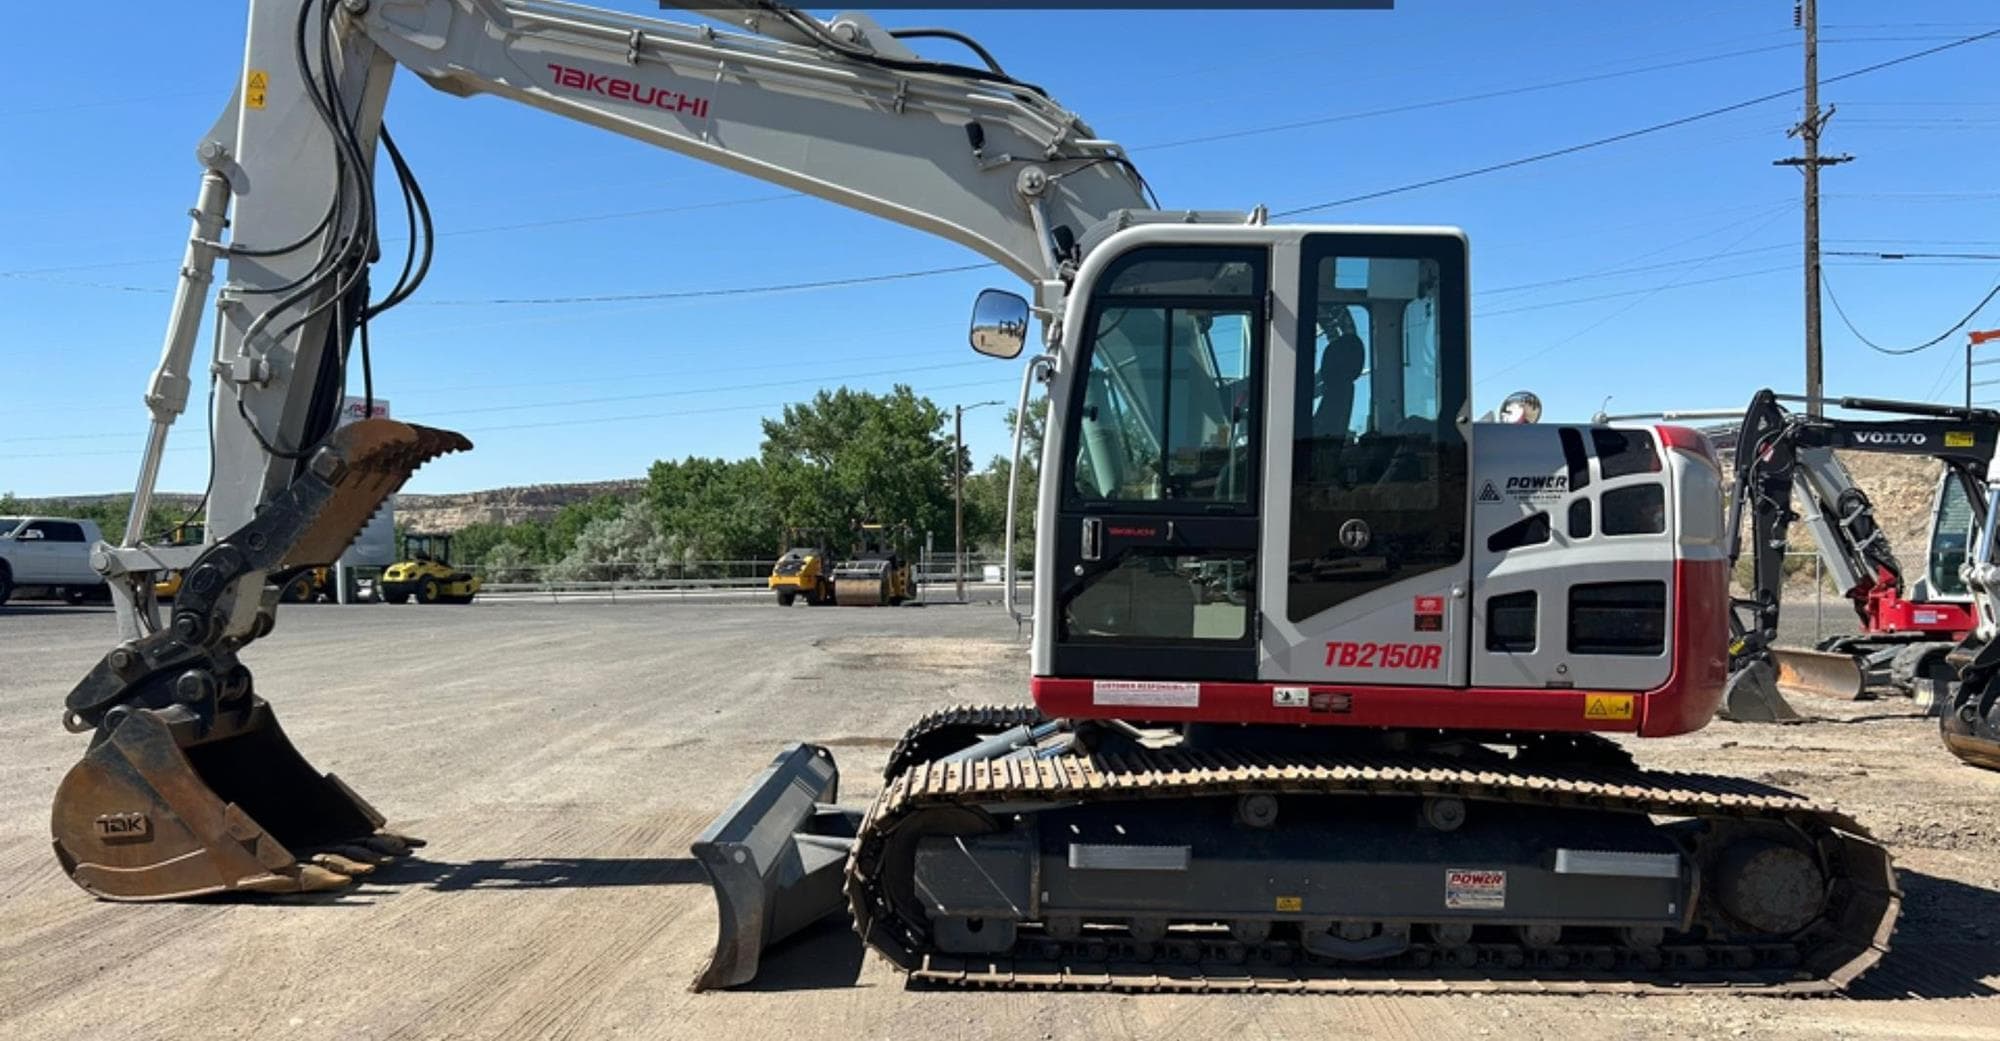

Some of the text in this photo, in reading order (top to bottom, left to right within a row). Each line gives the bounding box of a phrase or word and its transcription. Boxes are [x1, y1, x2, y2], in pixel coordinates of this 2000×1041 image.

[1853, 431, 1927, 444] VOLVO
[1506, 476, 1568, 489] POWER
[1325, 642, 1442, 669] TB2150R
